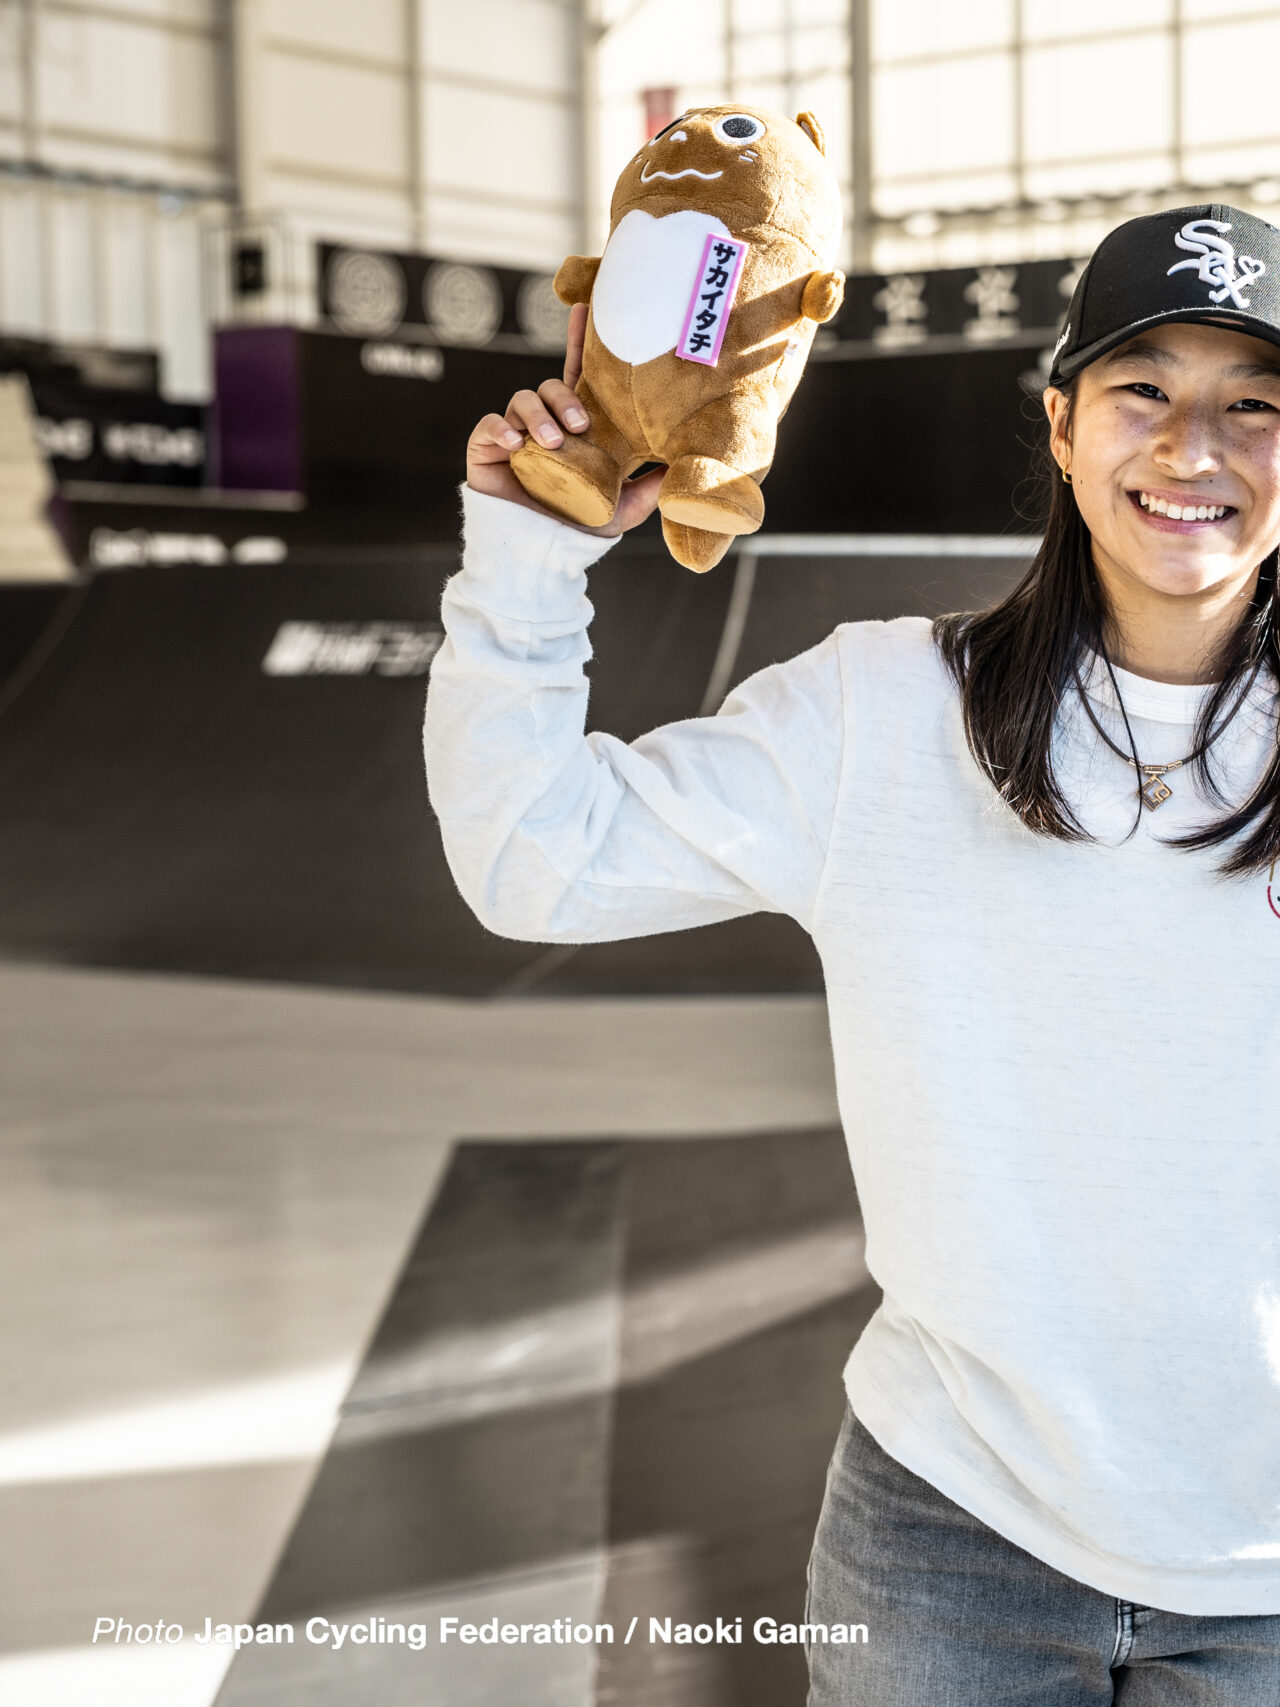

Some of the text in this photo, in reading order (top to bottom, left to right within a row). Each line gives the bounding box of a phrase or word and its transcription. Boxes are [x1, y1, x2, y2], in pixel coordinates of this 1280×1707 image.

[690, 243, 736, 354] サカイタチ
